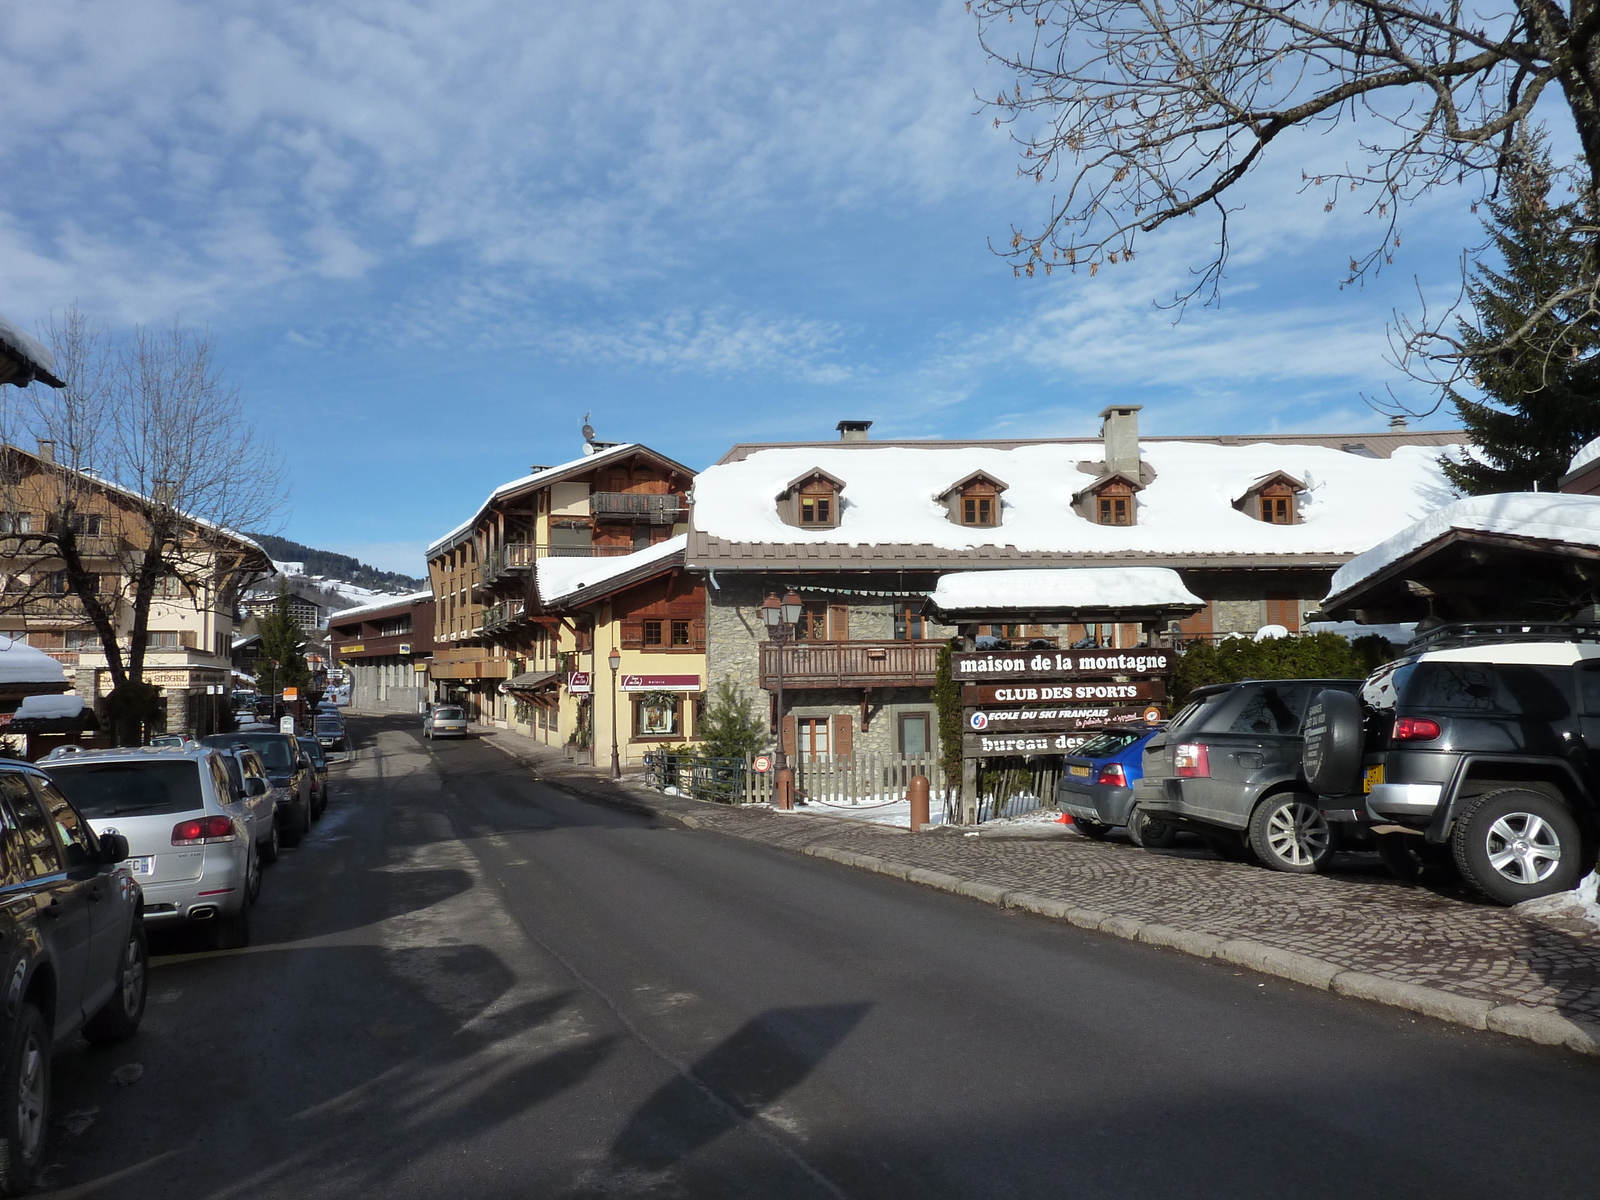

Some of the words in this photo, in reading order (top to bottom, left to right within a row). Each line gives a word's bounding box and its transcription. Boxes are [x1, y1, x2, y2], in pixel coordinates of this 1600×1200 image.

[960, 655, 1025, 673] maison
[1030, 654, 1051, 671] de
[1055, 653, 1073, 671] la
[1079, 654, 1167, 672] montagne
[154, 674, 188, 682] SIEGEL
[994, 688, 1038, 701] CLUB
[1041, 687, 1073, 700] DES
[1075, 685, 1137, 699] SPORTS
[988, 711, 1020, 721] ECOLE
[1020, 711, 1038, 720] DU
[1038, 710, 1057, 719] SKI
[1058, 709, 1109, 719] FRANÇAIS
[981, 737, 1048, 752] bureau
[1054, 735, 1085, 749] des
